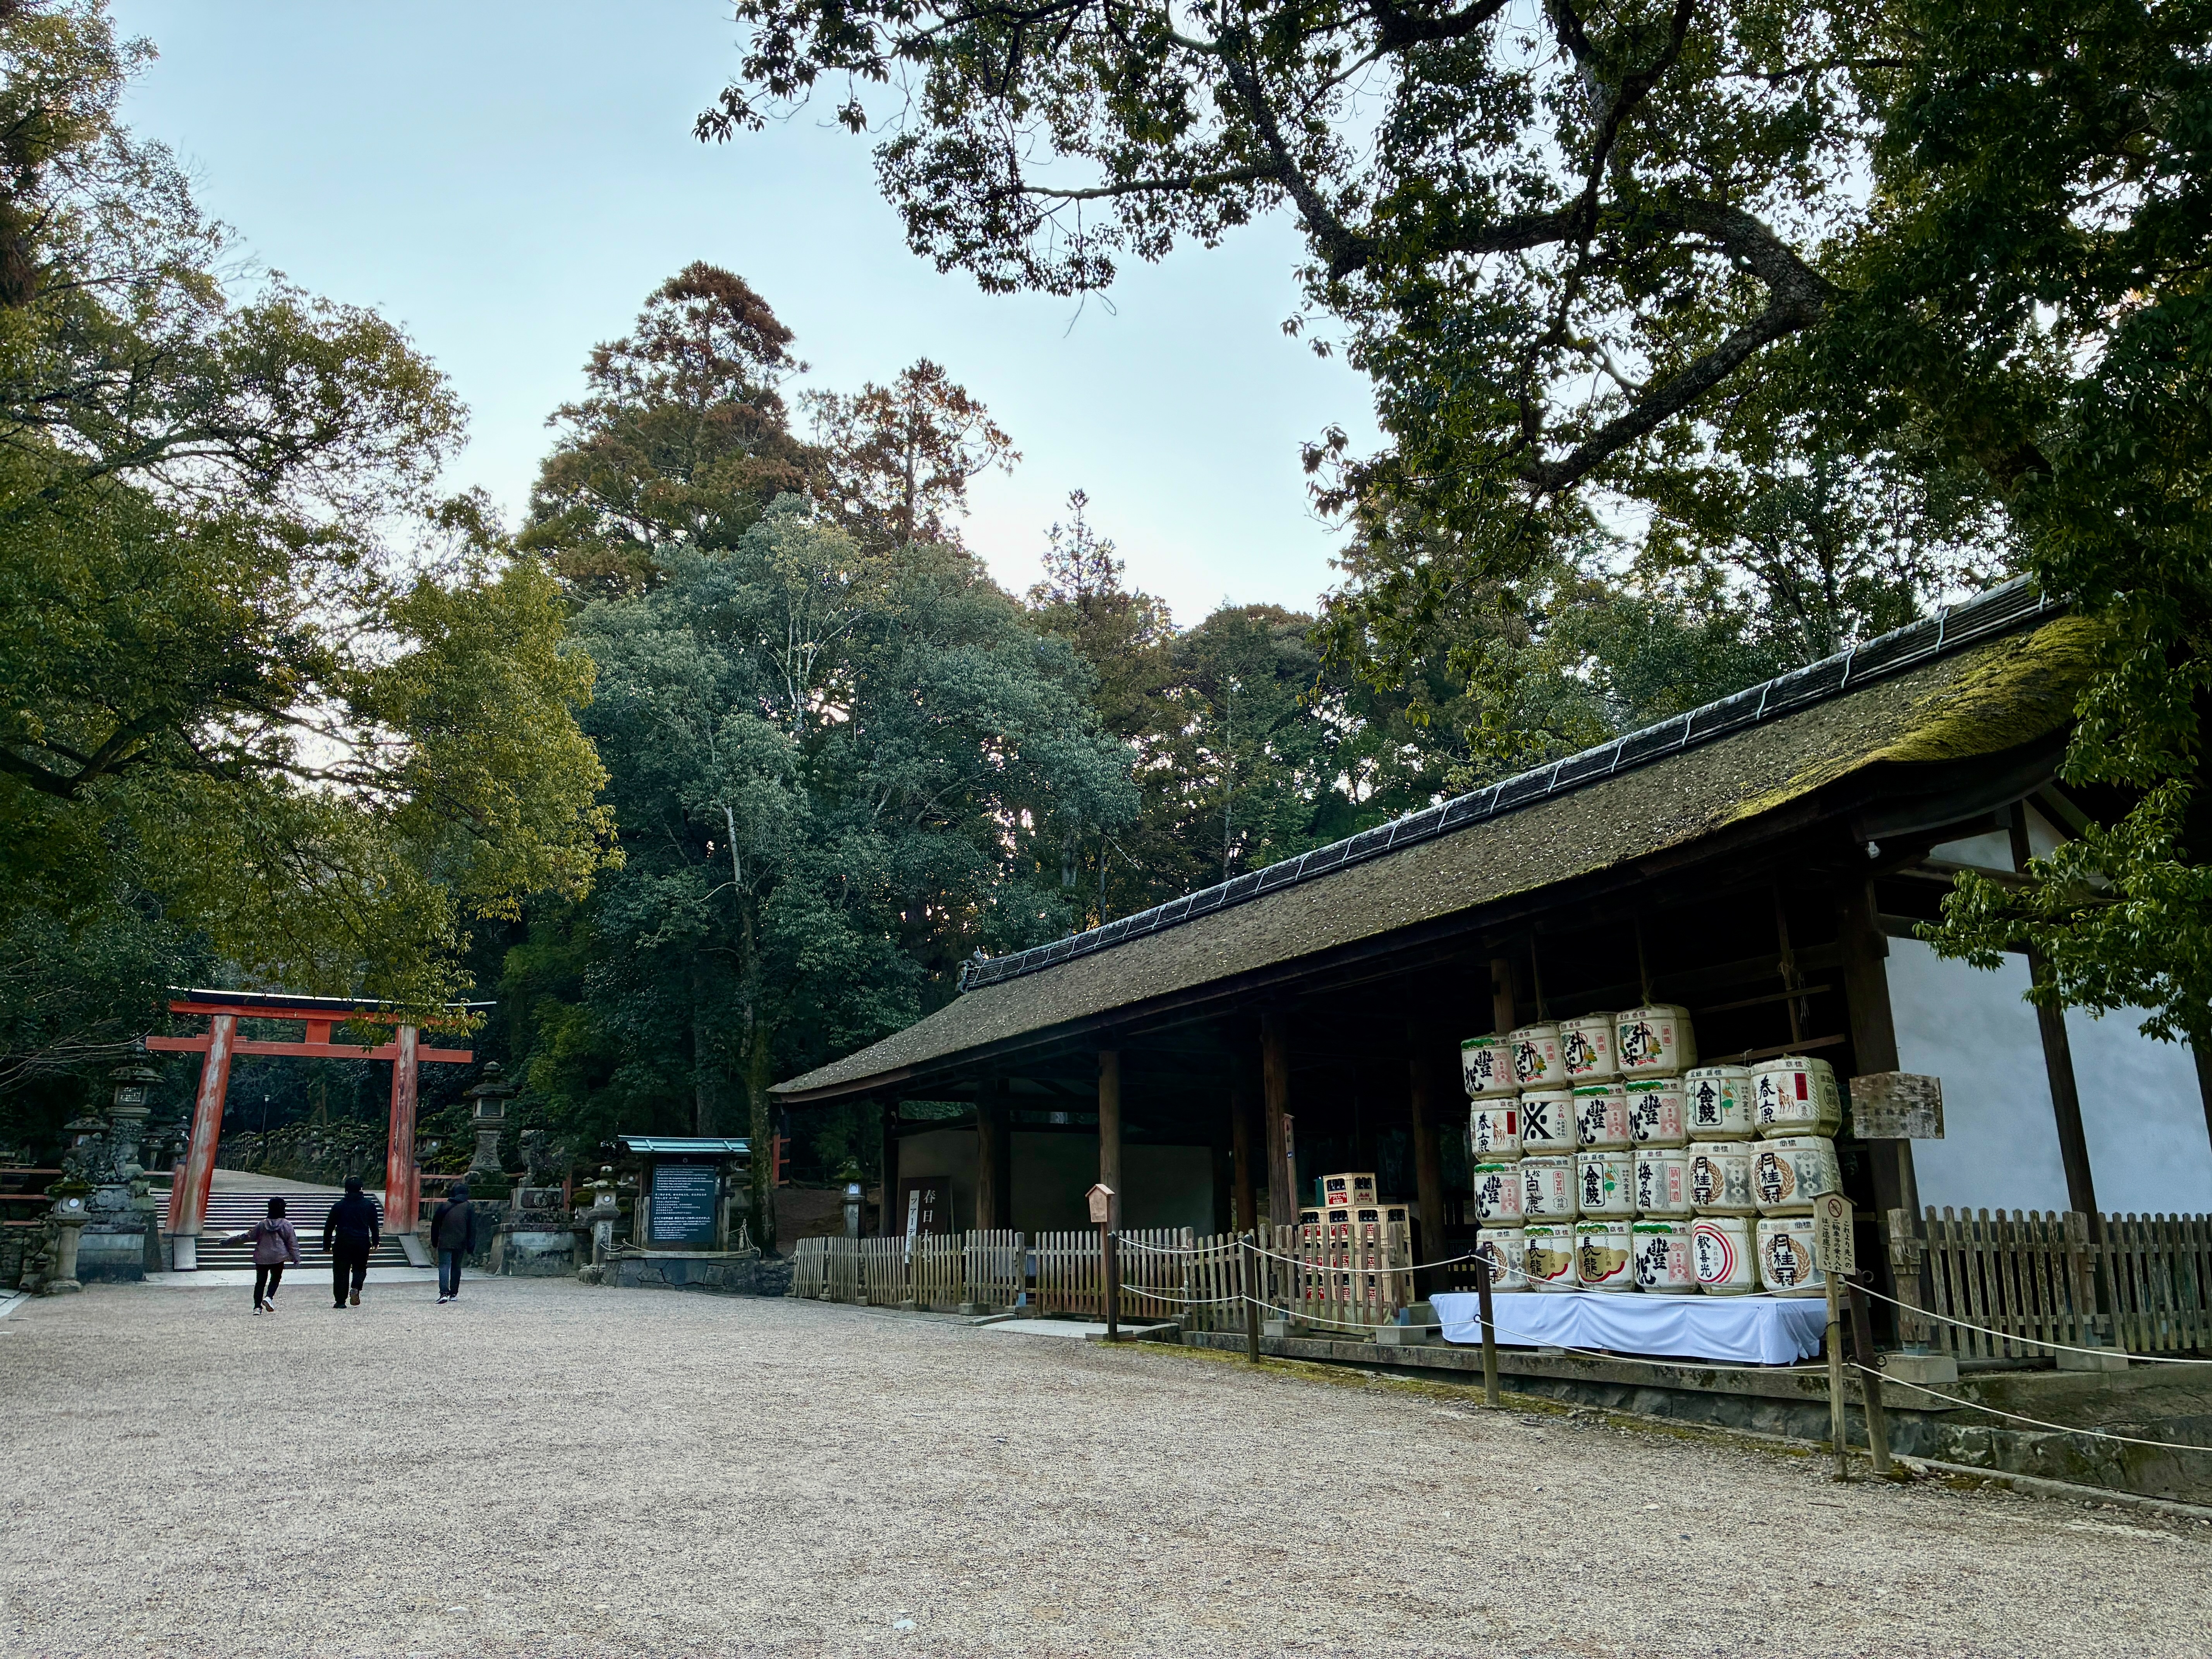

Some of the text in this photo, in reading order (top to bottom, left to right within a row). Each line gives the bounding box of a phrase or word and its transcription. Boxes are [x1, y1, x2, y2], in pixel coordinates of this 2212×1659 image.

[1758, 1074, 1776, 1124] 春鹿
[1477, 1111, 1491, 1152] 春鹿
[1638, 1160, 1654, 1209] 梅乃宿
[1694, 1156, 1712, 1205] 月桂冠
[1760, 1152, 1781, 1204] 月桂冠
[1528, 1239, 1547, 1278] 長龍
[1582, 1236, 1603, 1277] 長龍
[1772, 1234, 1796, 1287] 月桂冠
[1843, 1221, 1852, 1268] これより先への
